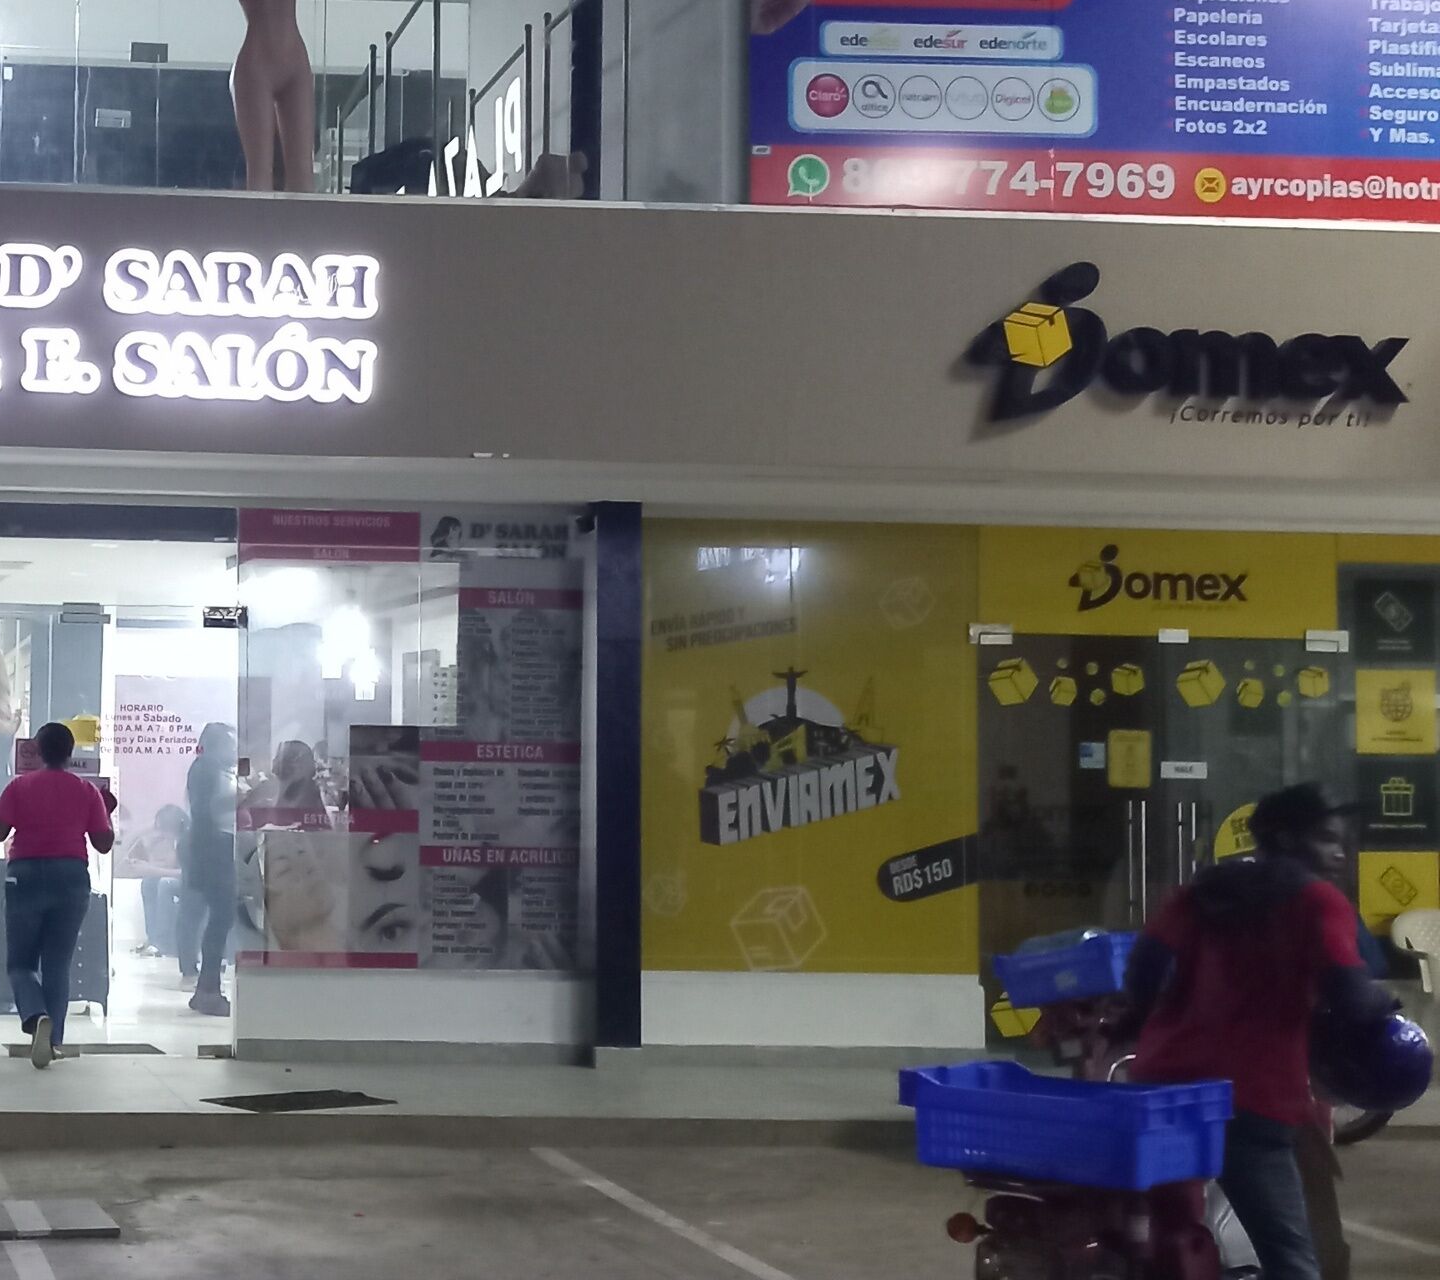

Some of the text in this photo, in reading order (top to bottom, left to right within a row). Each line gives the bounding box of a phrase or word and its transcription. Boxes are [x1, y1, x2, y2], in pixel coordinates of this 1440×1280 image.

[979, 35, 1048, 51] edenorte
[1173, 29, 1268, 47] Escolares
[1174, 51, 1265, 68] Escaneos
[1174, 74, 1290, 92] Empastados
[809, 89, 842, 101] Claro
[1175, 95, 1328, 115] Encuadernación
[1369, 105, 1439, 125] Seguro
[1175, 117, 1268, 135] Fotos 2x2
[1369, 127, 1436, 144] Y Mas.
[108, 252, 374, 314] SARAH
[117, 325, 372, 398] SALÓN
[1297, 412, 1340, 429] por
[120, 704, 164, 712] HORARIO
[443, 846, 481, 863] UÑAS
[487, 849, 505, 863] EN
